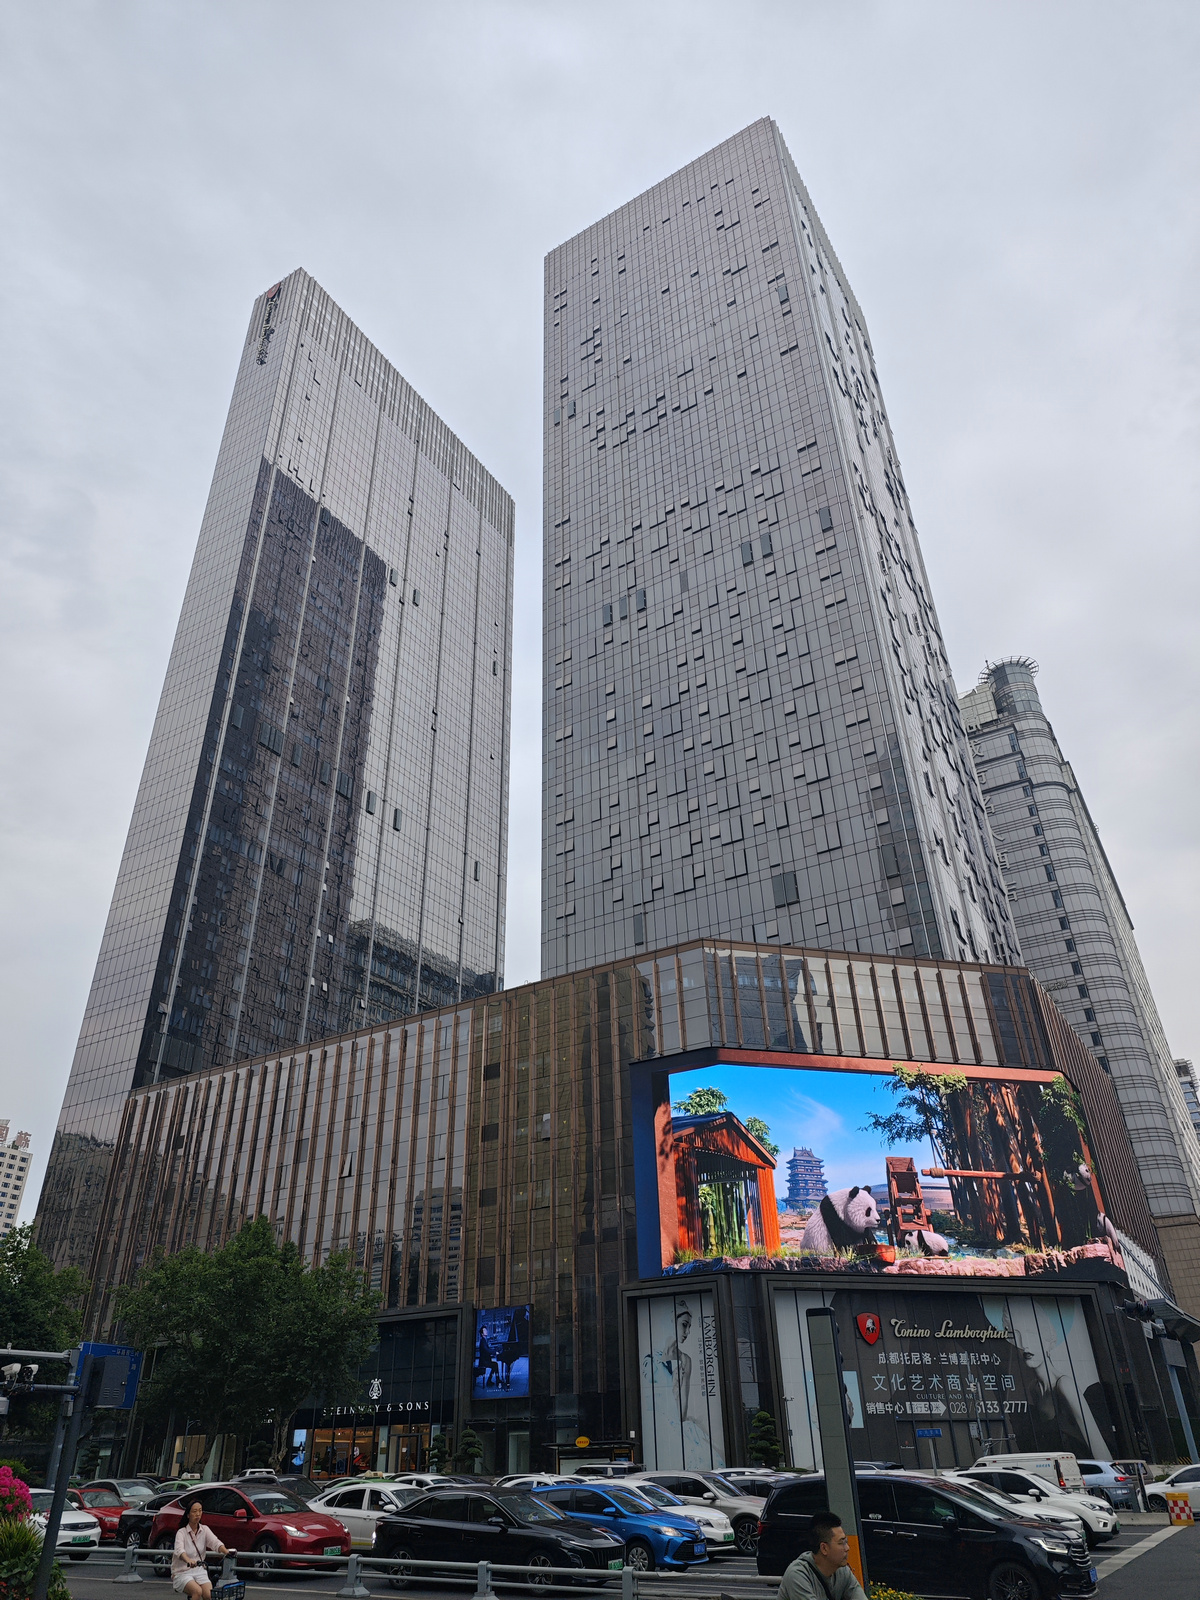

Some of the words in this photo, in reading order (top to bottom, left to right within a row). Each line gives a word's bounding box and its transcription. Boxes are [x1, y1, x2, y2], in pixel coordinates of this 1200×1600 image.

[891, 1318, 931, 1338] Tonino
[935, 1319, 1009, 1343] Lamborghini
[703, 1316, 716, 1396] LAMBORGHINI
[386, 1403, 392, 1412] &
[398, 1401, 429, 1412] SONS
[866, 1402, 905, 1415] 销售中心
[950, 1401, 968, 1414] 028
[1002, 1401, 1028, 1414] 2777
